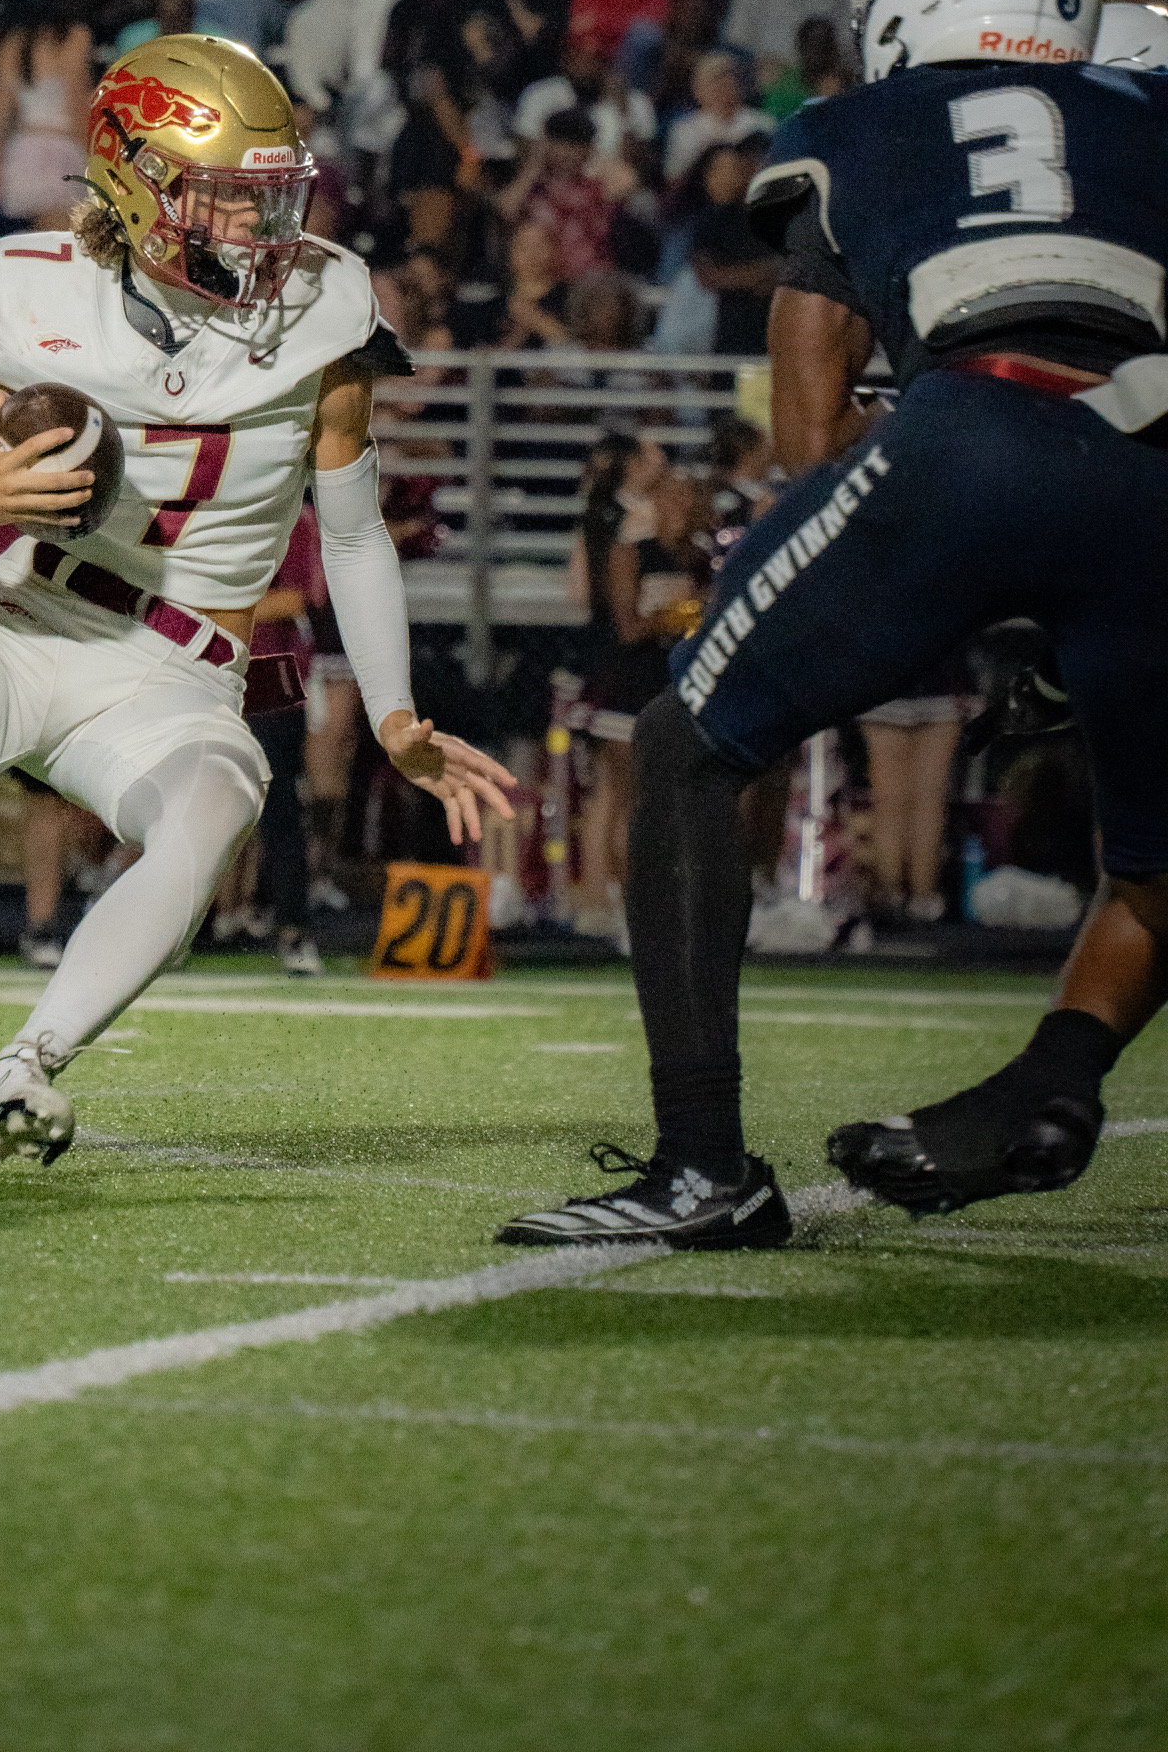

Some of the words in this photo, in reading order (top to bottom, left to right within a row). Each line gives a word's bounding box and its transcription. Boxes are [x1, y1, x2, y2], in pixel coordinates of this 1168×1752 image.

[252, 149, 293, 165] Riddell
[947, 84, 1075, 229] 3
[3, 242, 74, 263] 7
[139, 422, 234, 548] 7
[679, 595, 756, 716] SOUTH
[747, 444, 892, 613] GWINNETT
[380, 879, 477, 971] 20
